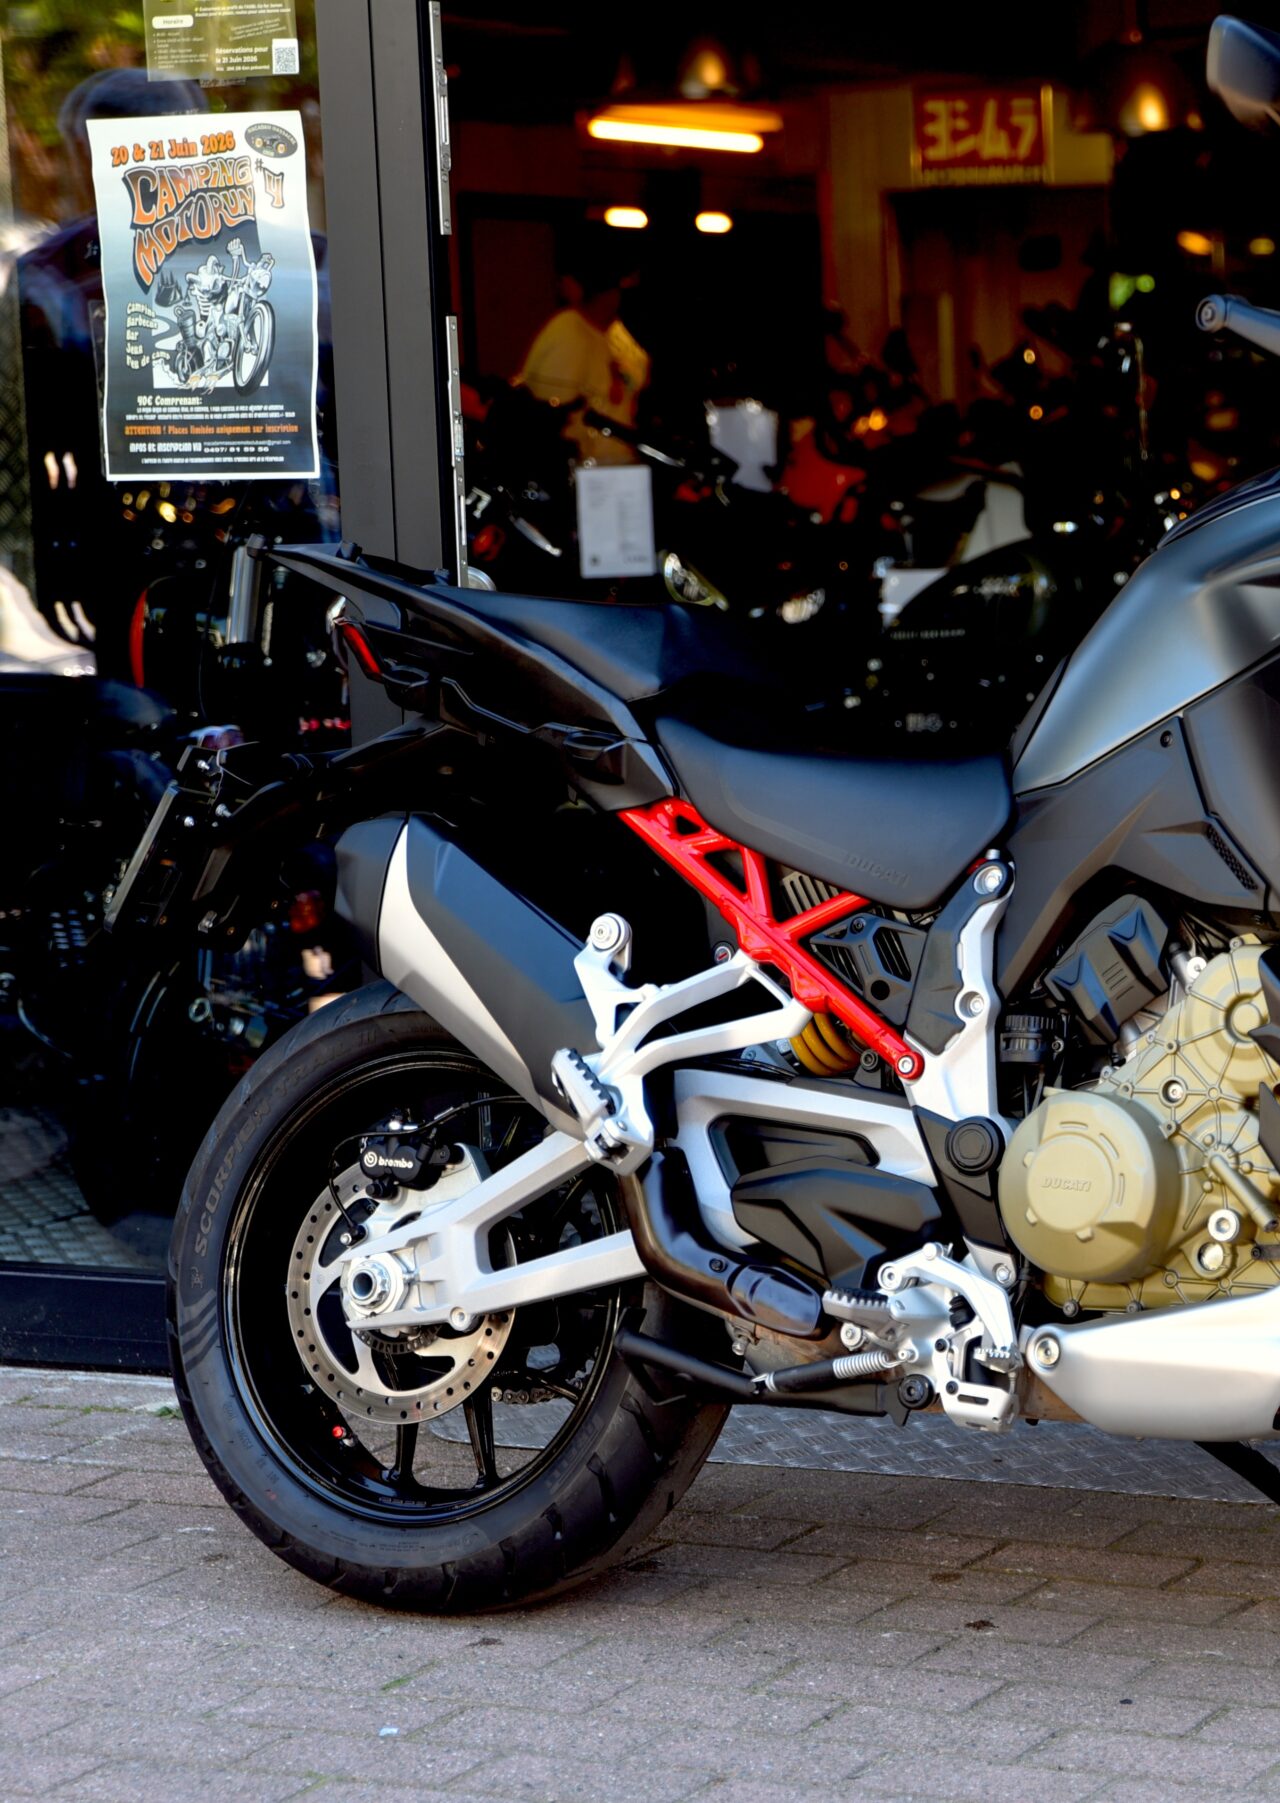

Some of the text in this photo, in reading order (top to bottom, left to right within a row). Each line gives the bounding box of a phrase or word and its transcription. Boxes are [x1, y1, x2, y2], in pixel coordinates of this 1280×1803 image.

[215, 46, 269, 54] Réservations pour
[111, 131, 236, 167] 20 & 21 Juin 2026
[134, 186, 256, 287] MOTORUN
[126, 329, 139, 341] Bar
[844, 853, 911, 888] DUCATI
[378, 1156, 413, 1168] brembo
[1041, 1176, 1092, 1192] DUCATI
